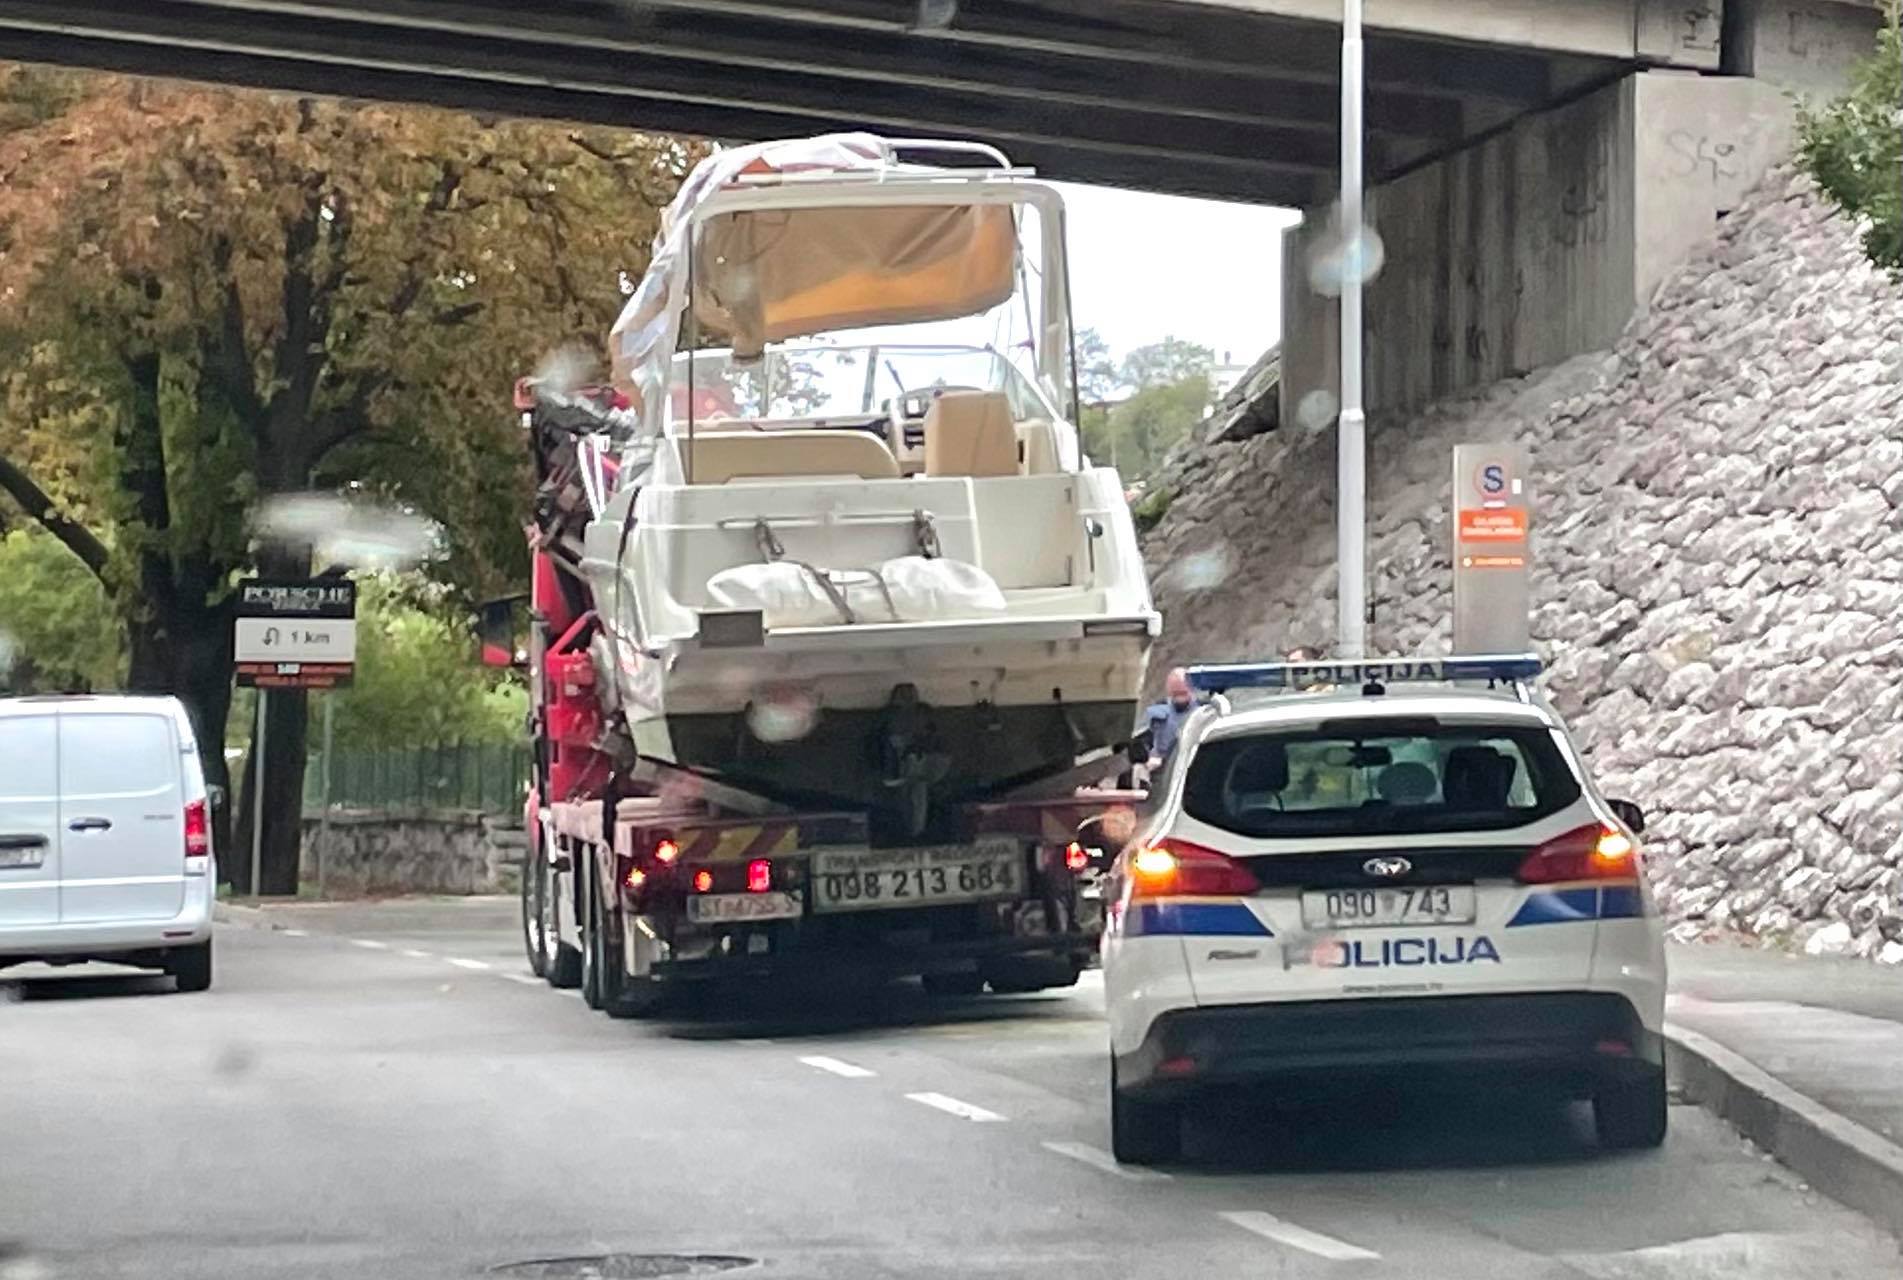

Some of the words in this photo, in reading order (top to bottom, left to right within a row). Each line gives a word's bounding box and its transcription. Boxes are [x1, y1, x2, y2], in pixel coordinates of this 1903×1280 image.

[1483, 465, 1504, 493] S
[304, 631, 330, 644] km
[1291, 662, 1437, 686] POLICIJA
[826, 871, 880, 900] 098
[892, 867, 947, 897] 213
[959, 861, 1014, 892] 684
[1326, 889, 1377, 919] 090
[1400, 888, 1451, 918] 743
